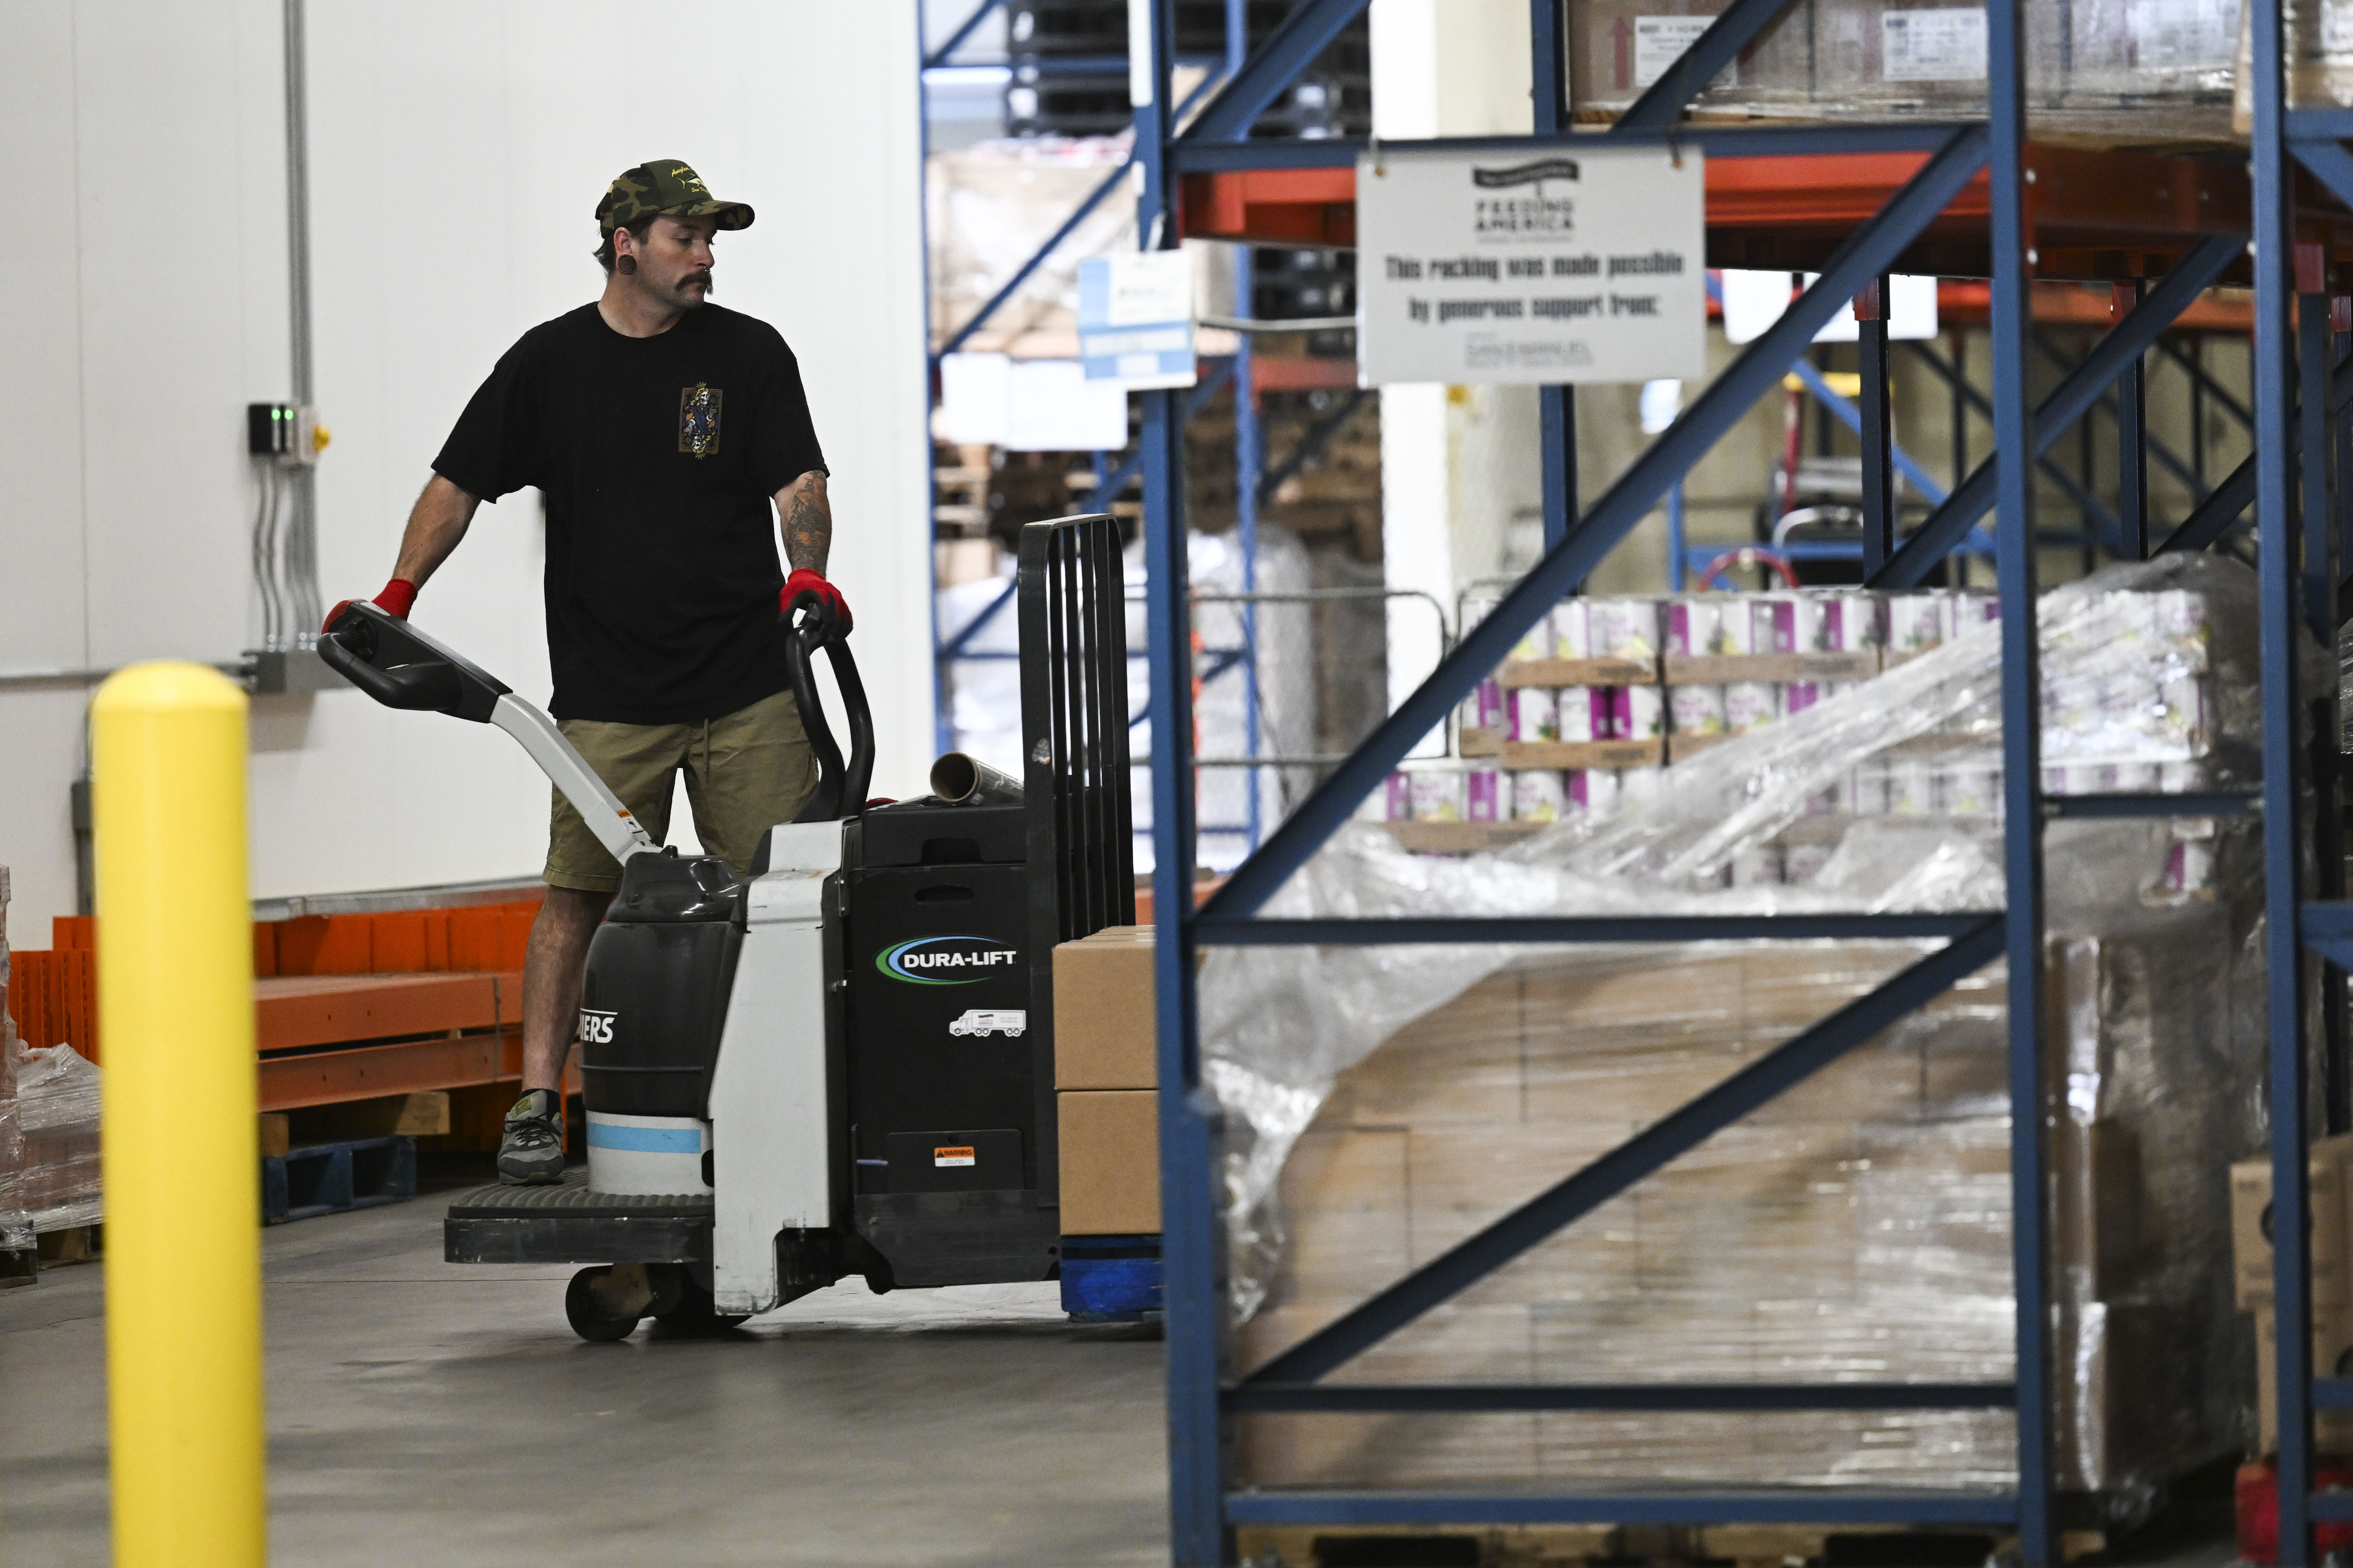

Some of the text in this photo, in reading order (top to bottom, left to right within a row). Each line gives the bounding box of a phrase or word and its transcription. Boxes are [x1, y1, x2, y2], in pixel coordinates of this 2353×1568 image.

[1475, 198, 1574, 214] FEEDING
[1475, 219, 1575, 232] AMERICA
[1385, 249, 1683, 283] This racking was made possible
[1408, 296, 1429, 325] by
[1438, 299, 1522, 324] generous
[1532, 295, 1602, 322] support
[904, 950, 1016, 968] DURA-LIFT
